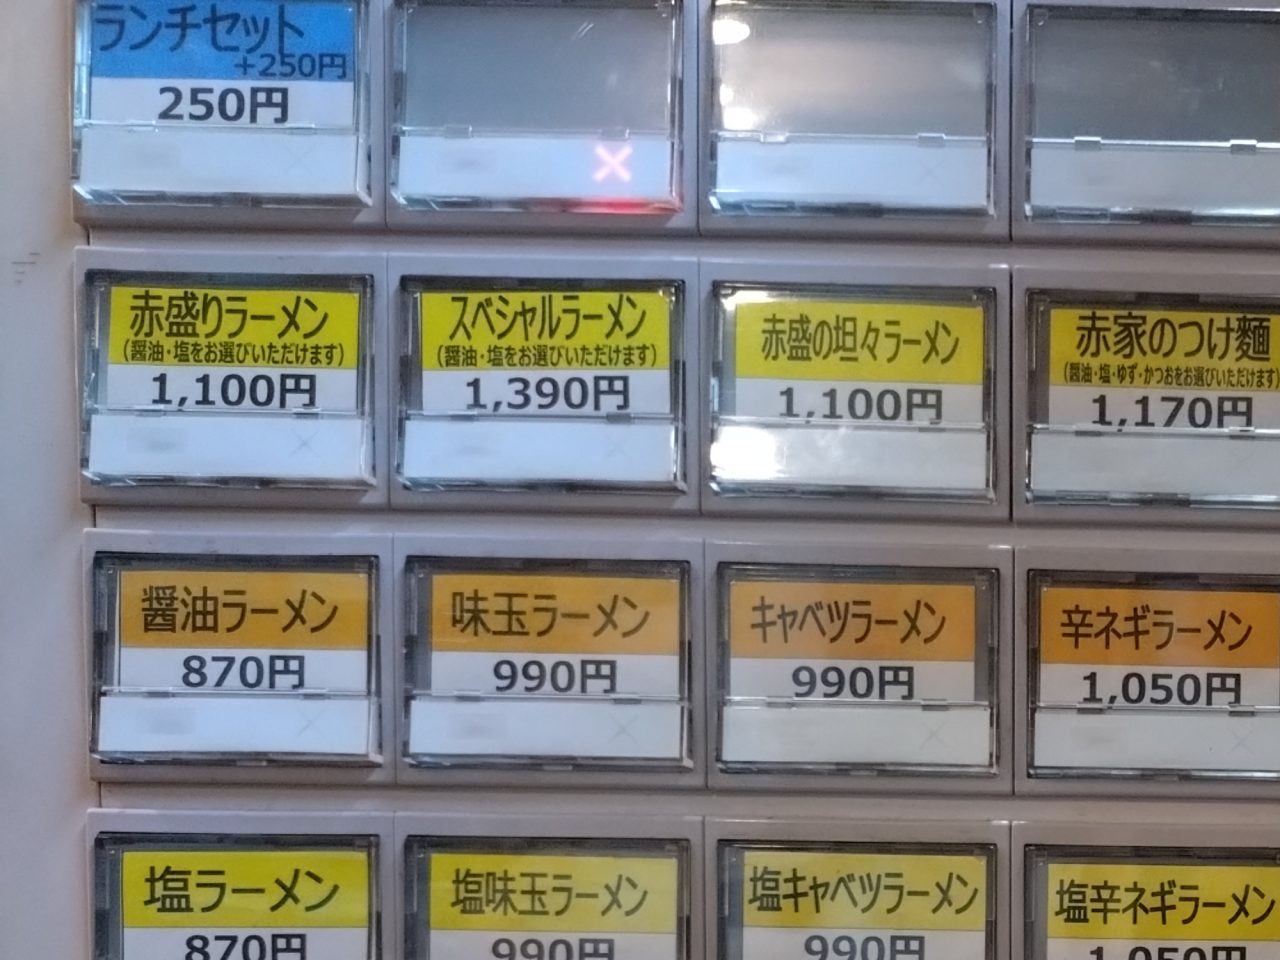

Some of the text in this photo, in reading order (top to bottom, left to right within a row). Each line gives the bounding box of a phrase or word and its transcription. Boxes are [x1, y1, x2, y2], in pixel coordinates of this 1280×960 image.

[94, 3, 304, 57] ランチセット
[234, 53, 346, 79] +250円
[158, 86, 289, 124] 250円
[130, 290, 329, 339] 赤盛りラーメン
[151, 372, 317, 410] 1,100円
[466, 375, 630, 412] 1,390円
[779, 386, 943, 424] 1,100円
[1092, 394, 1253, 431] 1,170円
[141, 585, 338, 635] 醤油ラーメン
[451, 590, 650, 638] 味玉ラーメン
[750, 596, 946, 645] キャベツラーメン
[1061, 605, 1253, 650] 辛ネギラーメン
[182, 655, 306, 690] 870円
[493, 659, 617, 694] 990円
[791, 666, 915, 700] 990円
[1081, 671, 1242, 707] 1,050円
[144, 866, 339, 914] 塩ラーメン
[452, 867, 648, 919] 塩味玉ラーメン
[749, 866, 979, 916] 塩キャベツラーメン
[1055, 880, 1276, 925] 塩辛ネギラーメン
